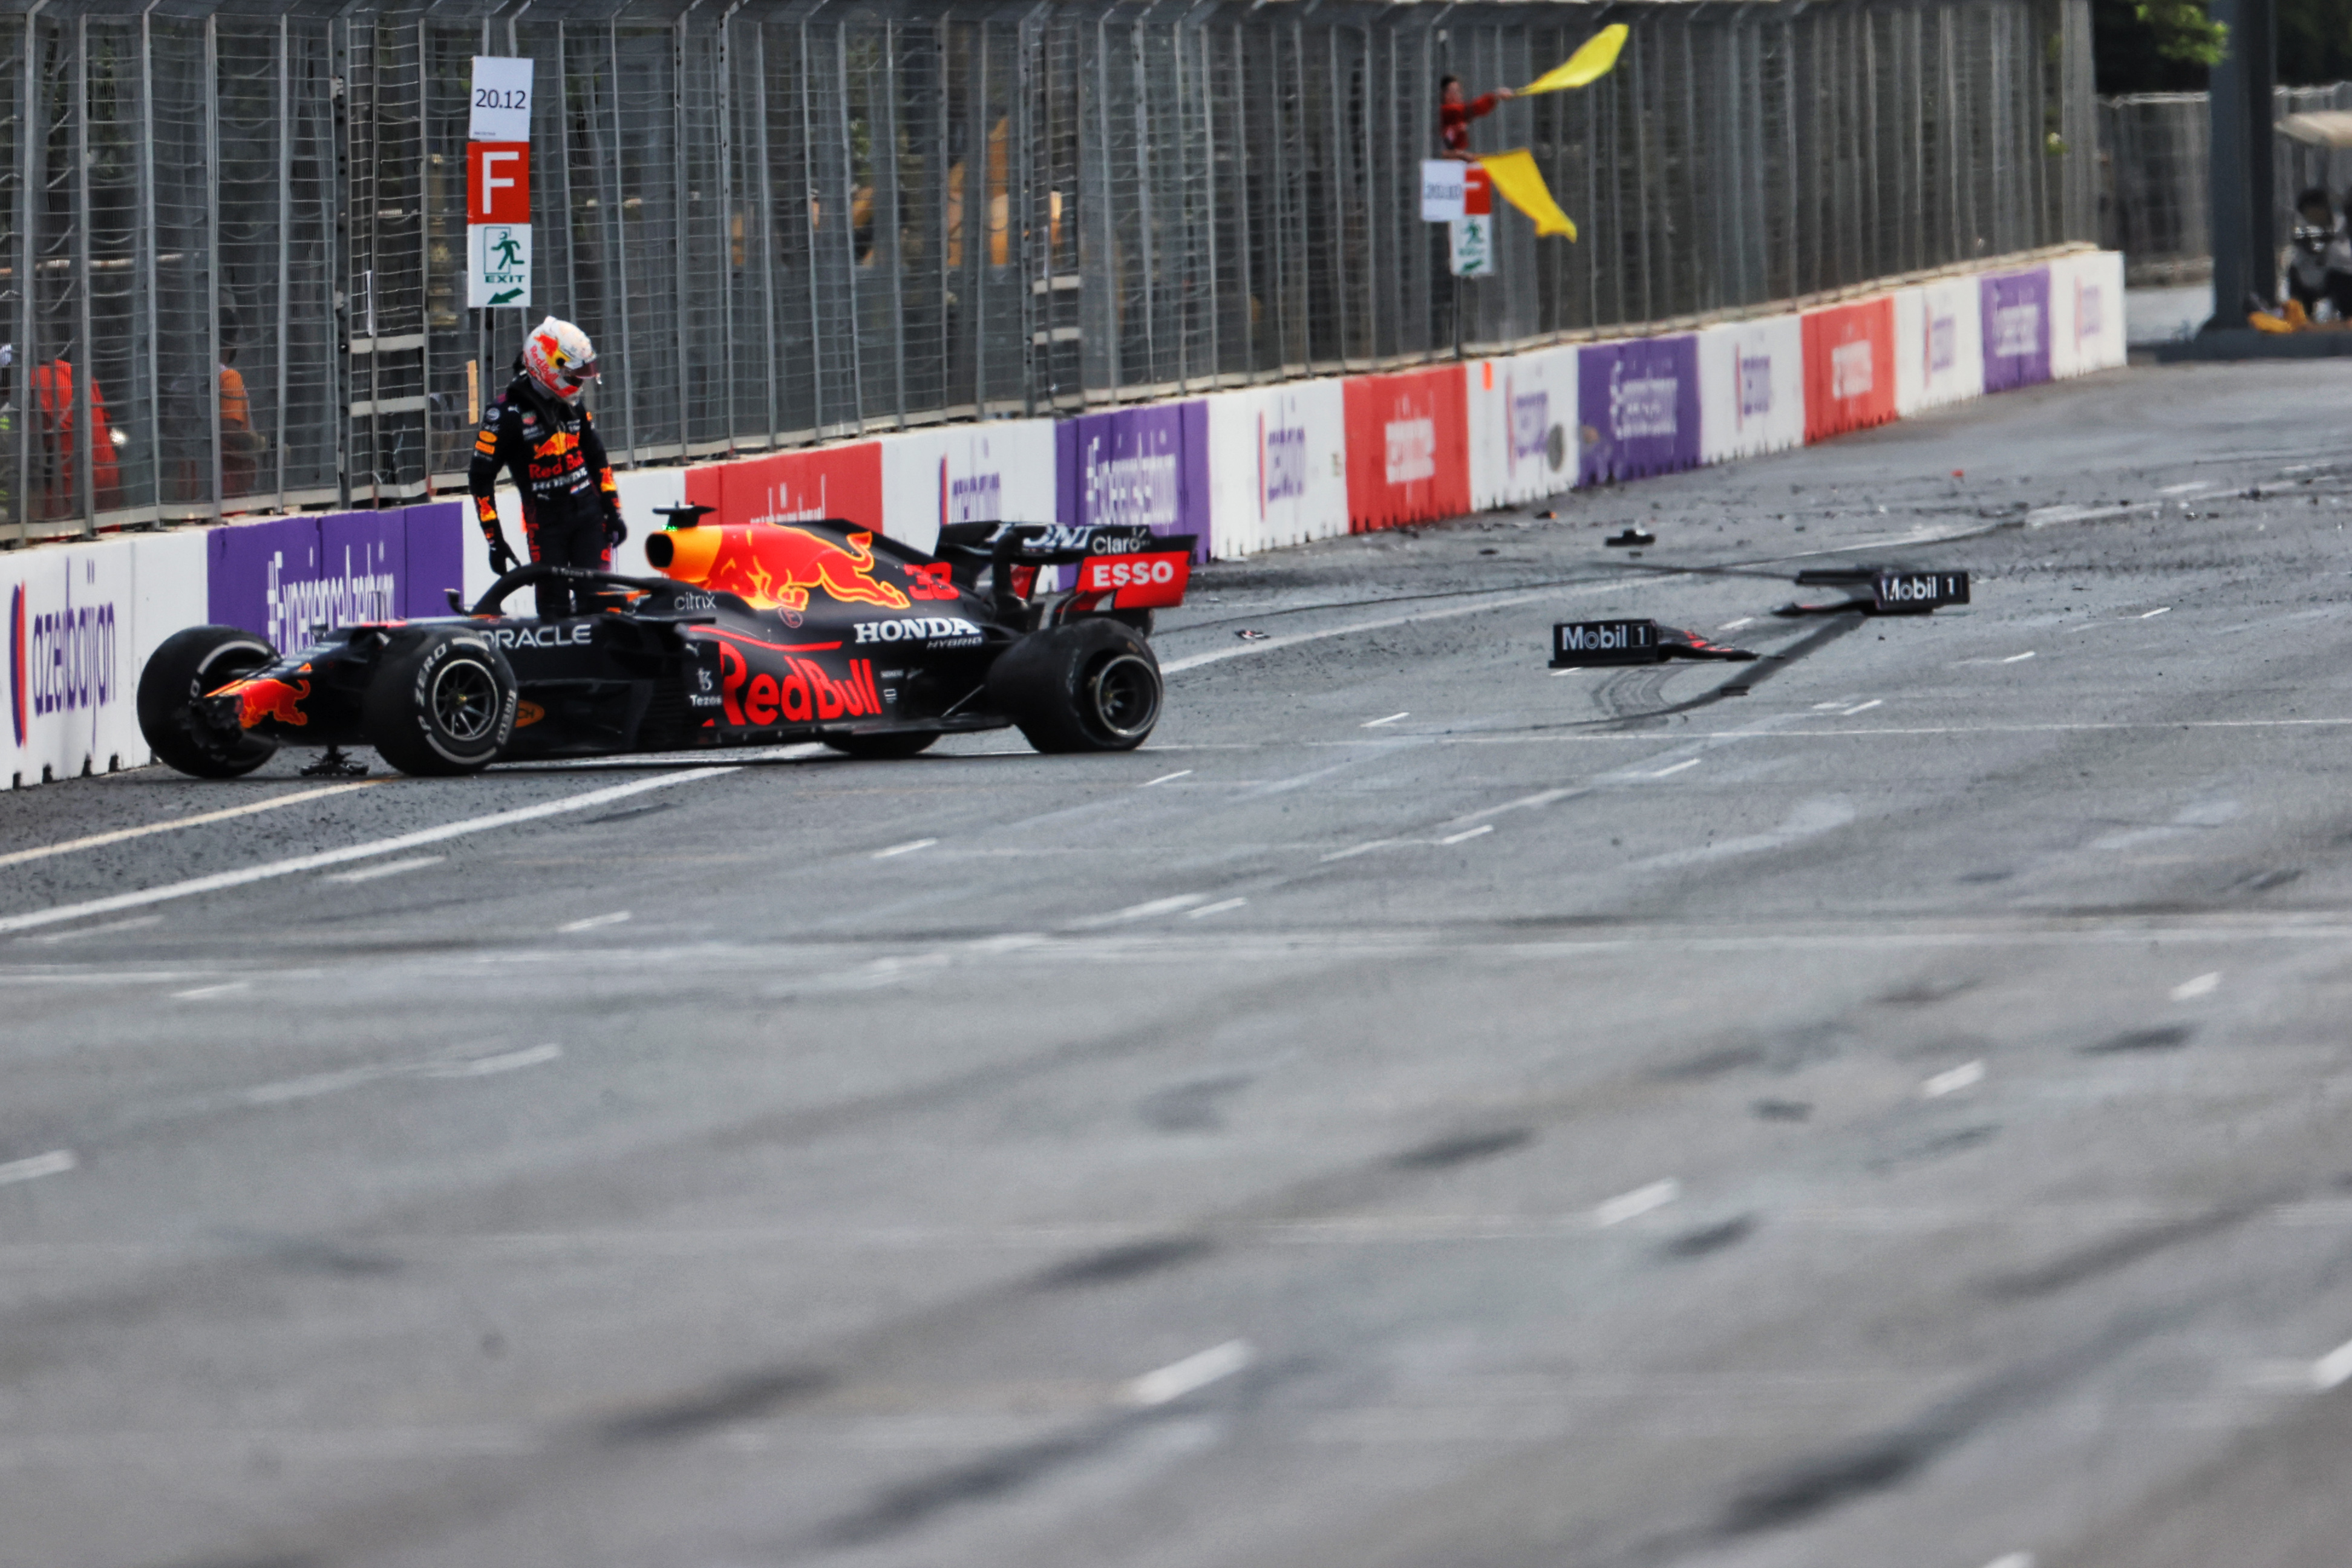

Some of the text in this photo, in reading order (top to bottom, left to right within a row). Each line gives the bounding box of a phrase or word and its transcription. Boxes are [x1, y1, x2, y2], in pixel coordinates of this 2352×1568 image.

[475, 88, 526, 109] 20.12
[482, 151, 519, 214] F
[485, 275, 526, 284] EXIT
[529, 457, 563, 479] Red
[1093, 535, 1141, 555] Claro
[903, 561, 960, 600] 33
[1093, 561, 1174, 587] ESSO
[1881, 575, 1955, 601] Mobil 1
[674, 591, 717, 610] citrix
[854, 617, 981, 644] HONDA
[1562, 624, 1645, 651] Mobil 1
[926, 636, 983, 650] HYBRID
[689, 694, 722, 707] Tezos
